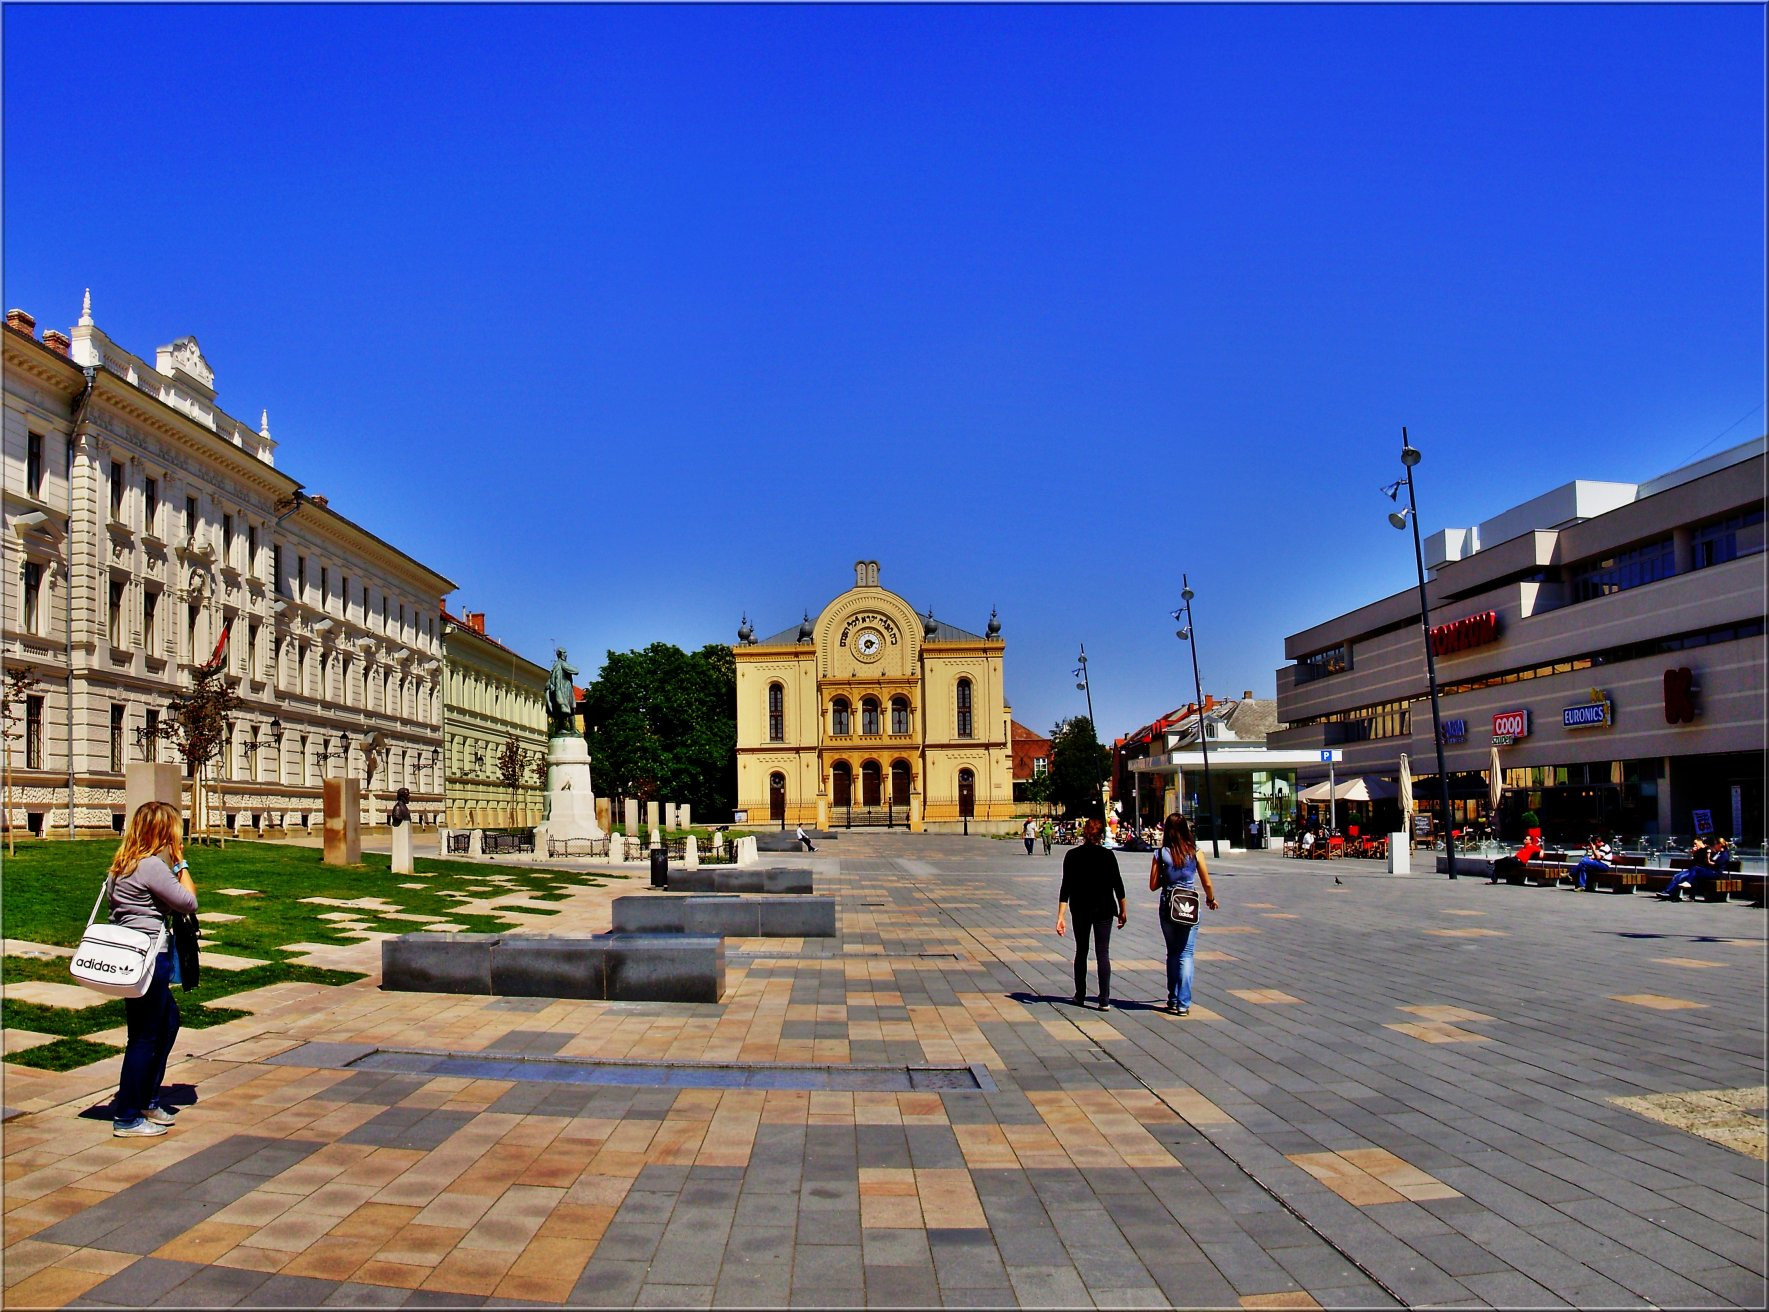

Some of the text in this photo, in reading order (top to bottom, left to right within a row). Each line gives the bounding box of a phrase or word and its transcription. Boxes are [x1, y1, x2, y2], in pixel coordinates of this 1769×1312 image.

[1564, 706, 1604, 724] EURONICS
[1323, 751, 1330, 760] P
[76, 958, 117, 974] adidas
